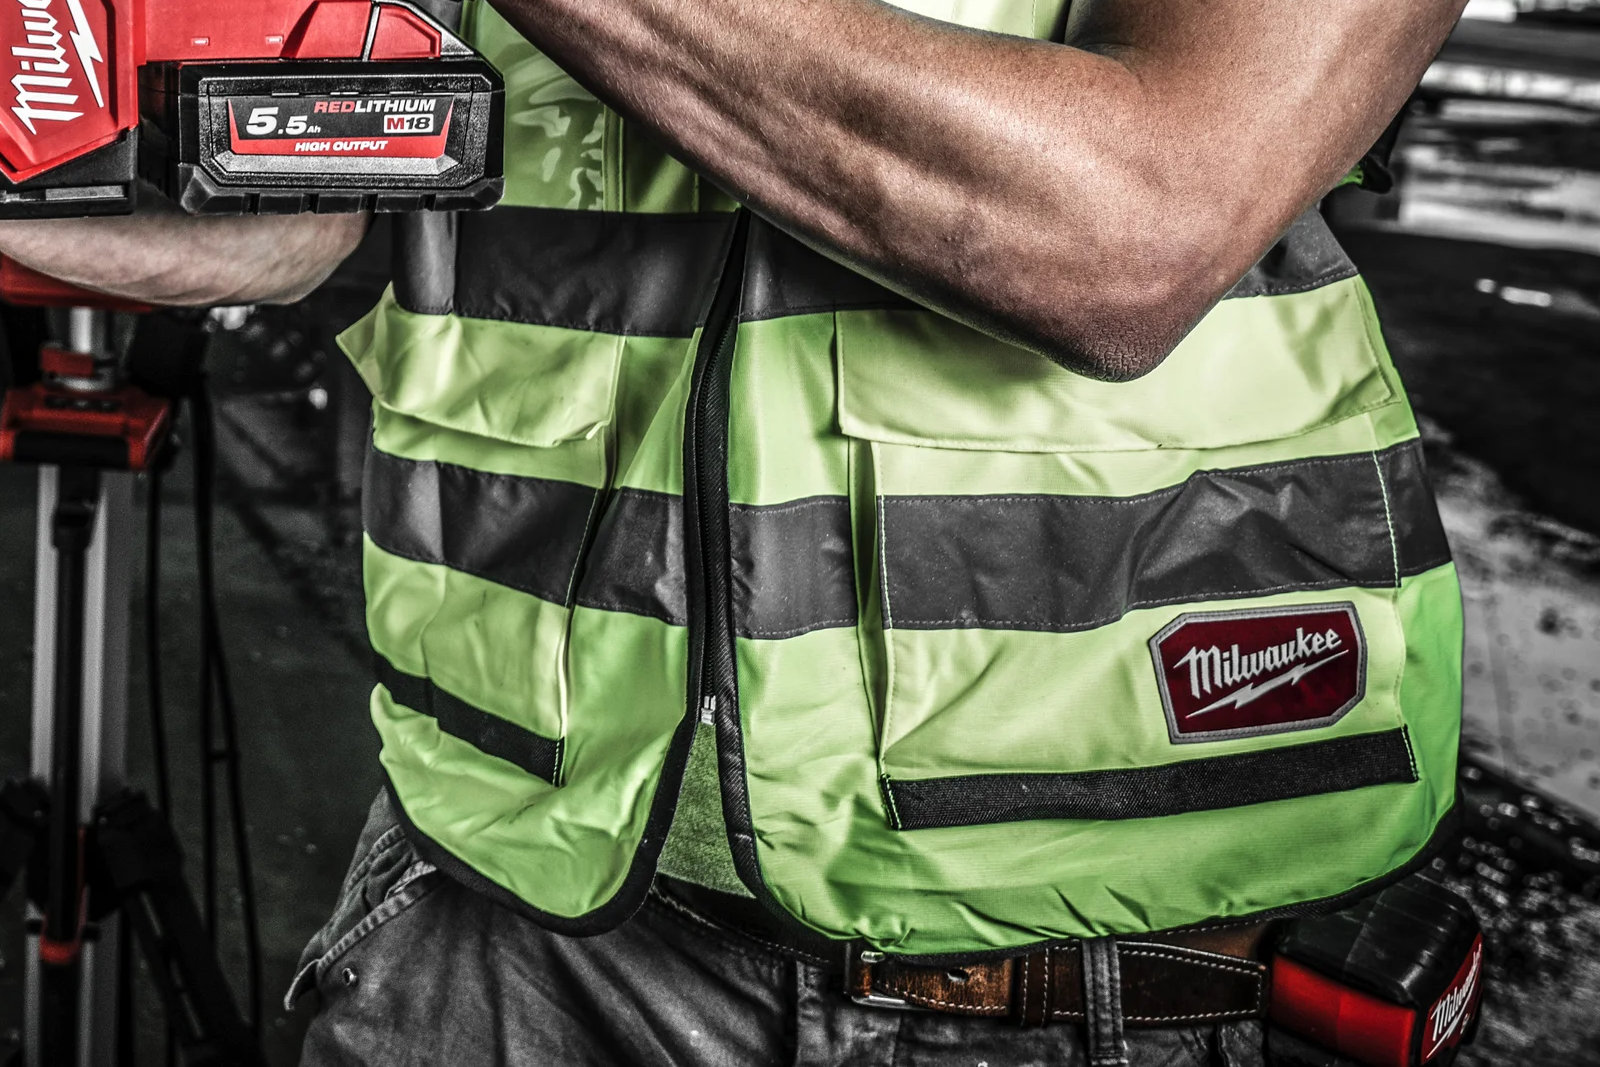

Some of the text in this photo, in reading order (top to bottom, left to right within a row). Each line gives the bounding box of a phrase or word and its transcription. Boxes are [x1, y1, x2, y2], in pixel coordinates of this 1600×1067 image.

[313, 99, 437, 114] REDLITHIUM
[386, 116, 432, 131] M18
[294, 139, 388, 152] HIGH OUTPUT
[1173, 626, 1343, 700] Milwaukee
